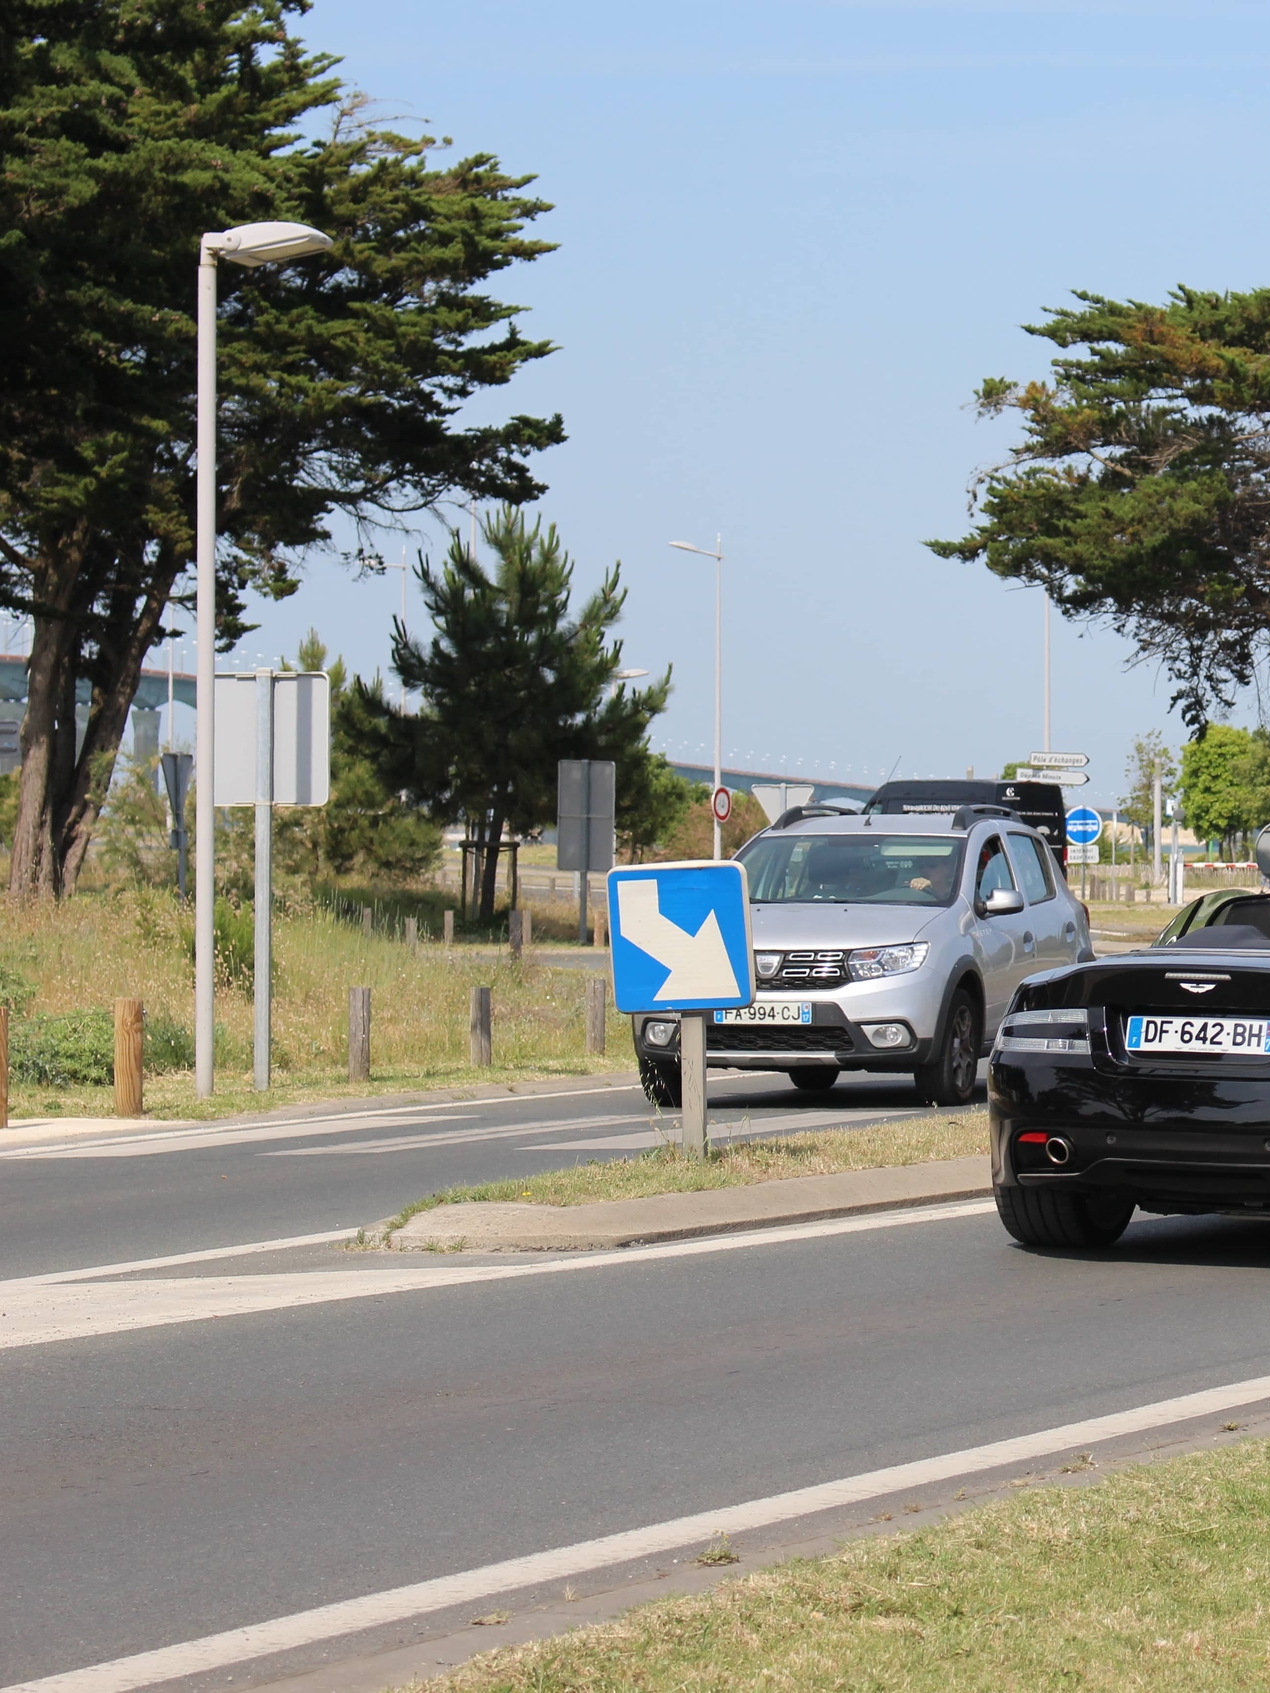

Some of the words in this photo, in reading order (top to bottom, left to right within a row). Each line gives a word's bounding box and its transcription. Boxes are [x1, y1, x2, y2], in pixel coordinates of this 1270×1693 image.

[1033, 755, 1046, 763] Pôle
[1048, 755, 1083, 766] d'échanges
[802, 1014, 809, 1022] 17
[1144, 1020, 1263, 1047] DF-642-BH
